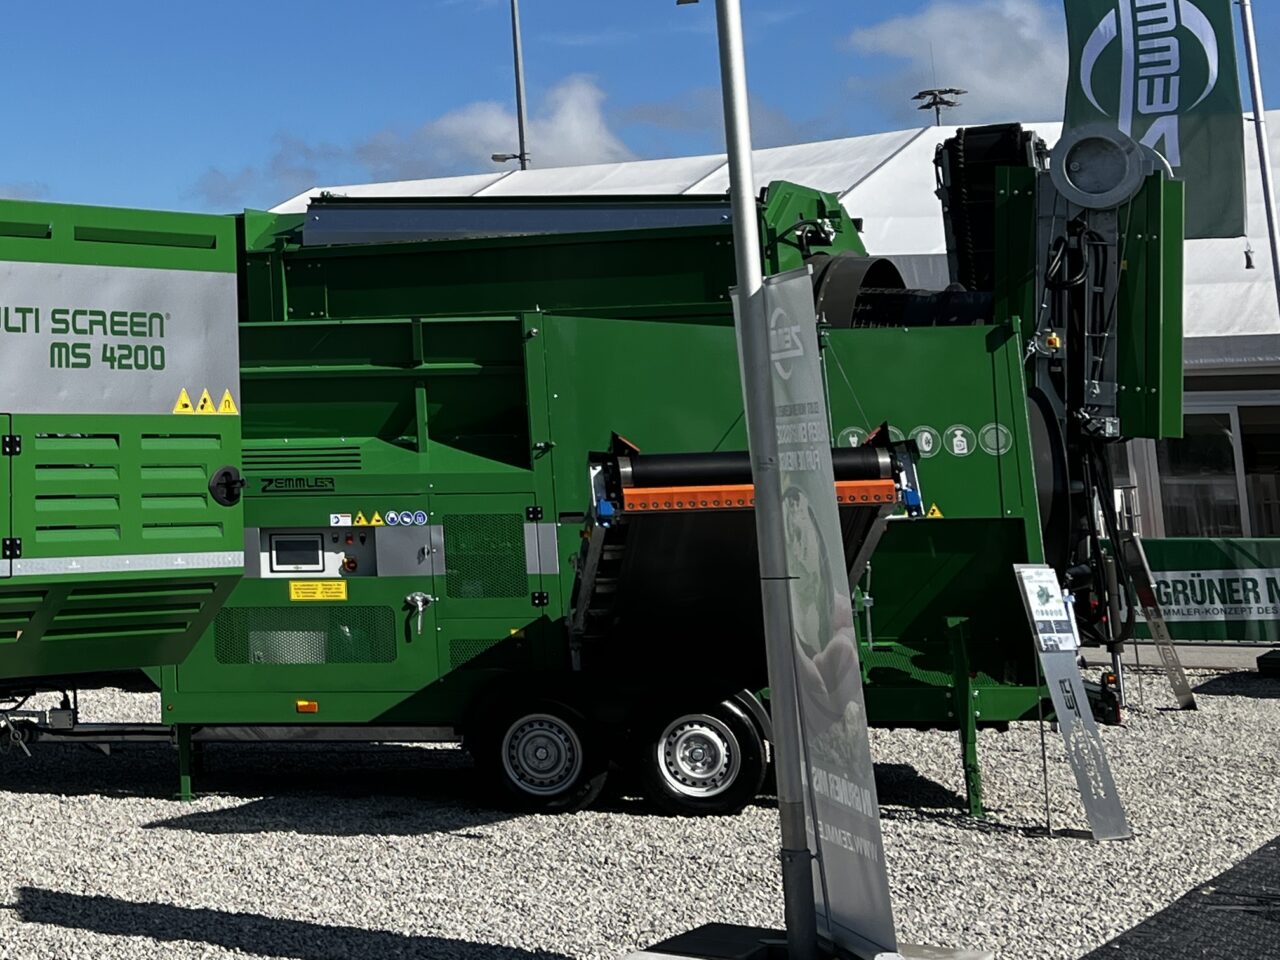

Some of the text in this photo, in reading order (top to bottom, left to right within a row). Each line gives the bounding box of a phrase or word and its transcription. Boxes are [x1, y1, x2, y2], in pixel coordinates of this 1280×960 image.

[50, 341, 166, 371] MS 4200
[260, 477, 336, 493] ZEMMLER
[1156, 572, 1261, 607] GRÜNER
[1162, 606, 1253, 617] MMLER-KONZEPT
[1257, 606, 1279, 616] DES
